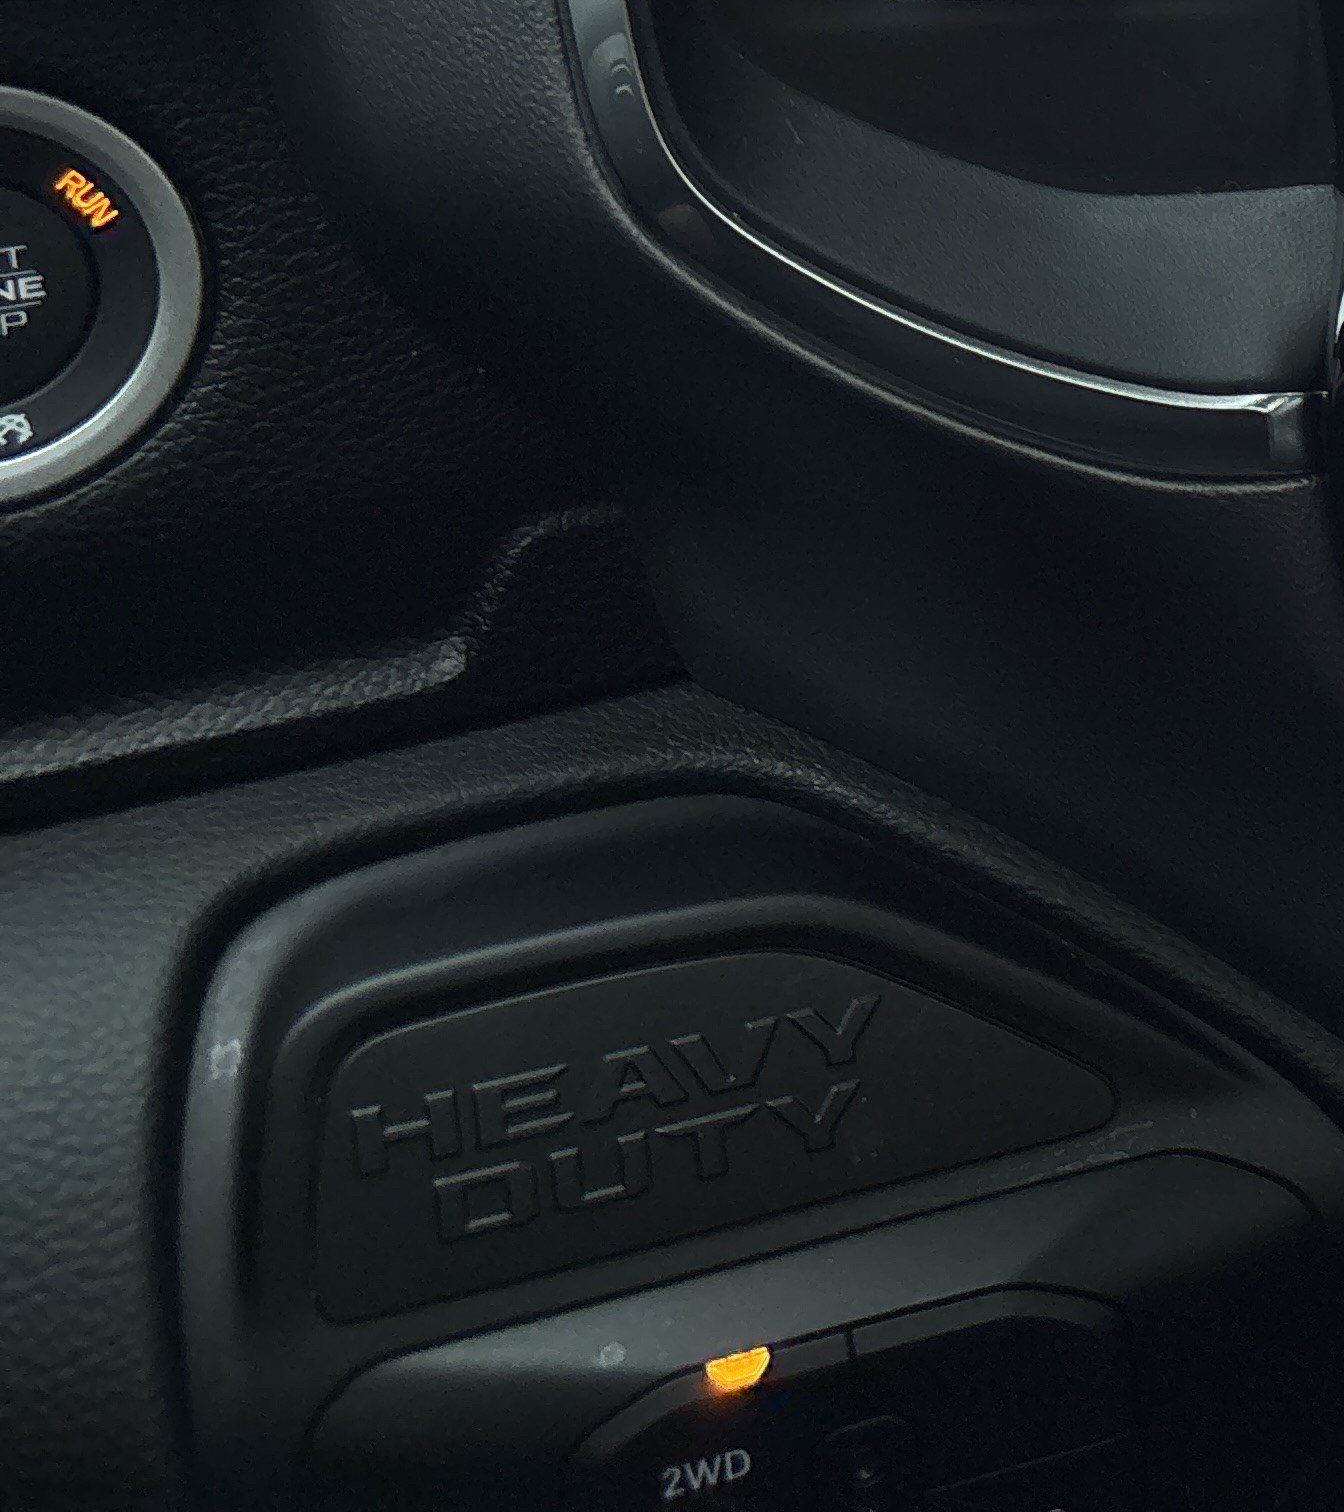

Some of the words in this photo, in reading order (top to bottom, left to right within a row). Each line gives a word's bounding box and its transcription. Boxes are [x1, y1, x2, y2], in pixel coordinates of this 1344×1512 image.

[54, 169, 119, 230] RUN
[350, 995, 883, 1179] HEAVY
[432, 1081, 862, 1244] DUTY
[660, 1448, 752, 1500] 2WD
